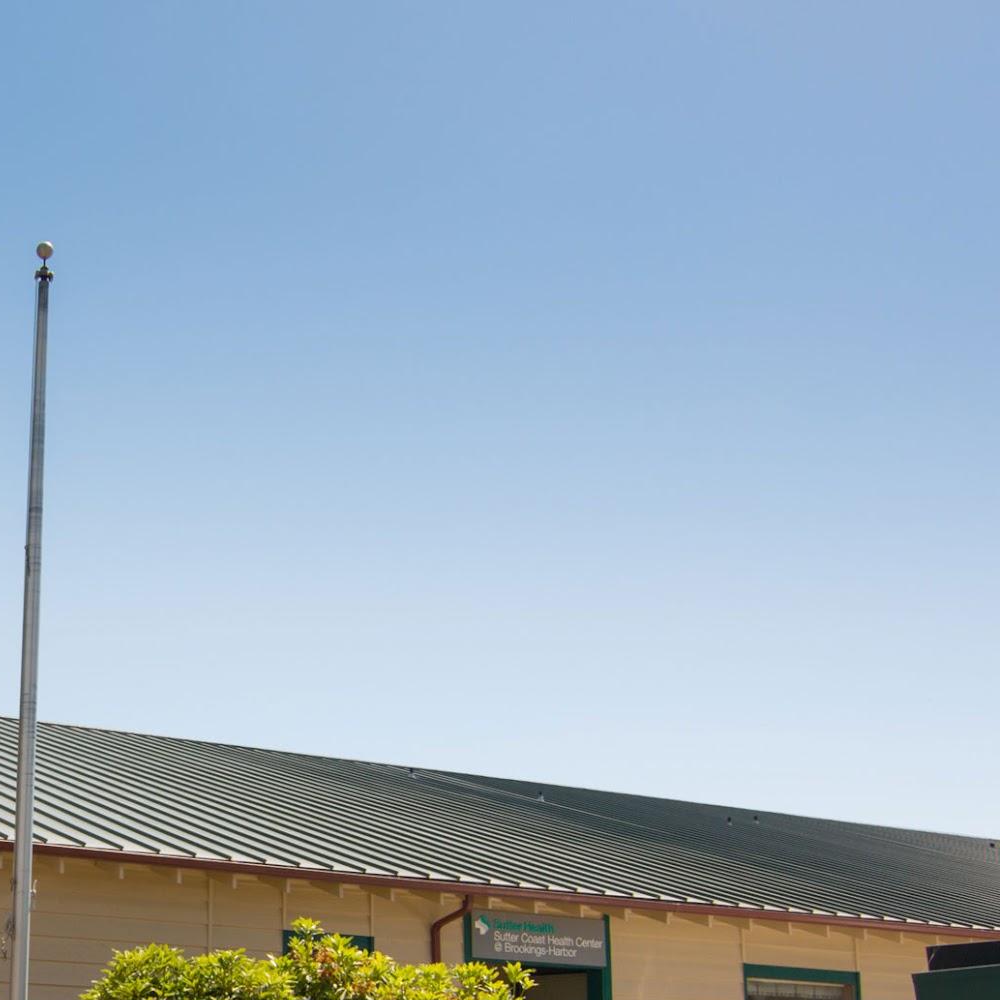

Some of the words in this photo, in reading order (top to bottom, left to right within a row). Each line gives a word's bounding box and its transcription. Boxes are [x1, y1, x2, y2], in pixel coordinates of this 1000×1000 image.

[494, 919, 522, 931] Sutter
[525, 920, 555, 933] Health
[494, 931, 519, 942] Sutter
[520, 932, 545, 944] Coast
[547, 935, 574, 947] Health
[575, 937, 603, 949] Center
[494, 942, 503, 952] @
[504, 942, 577, 958] Brookings-Harbor
